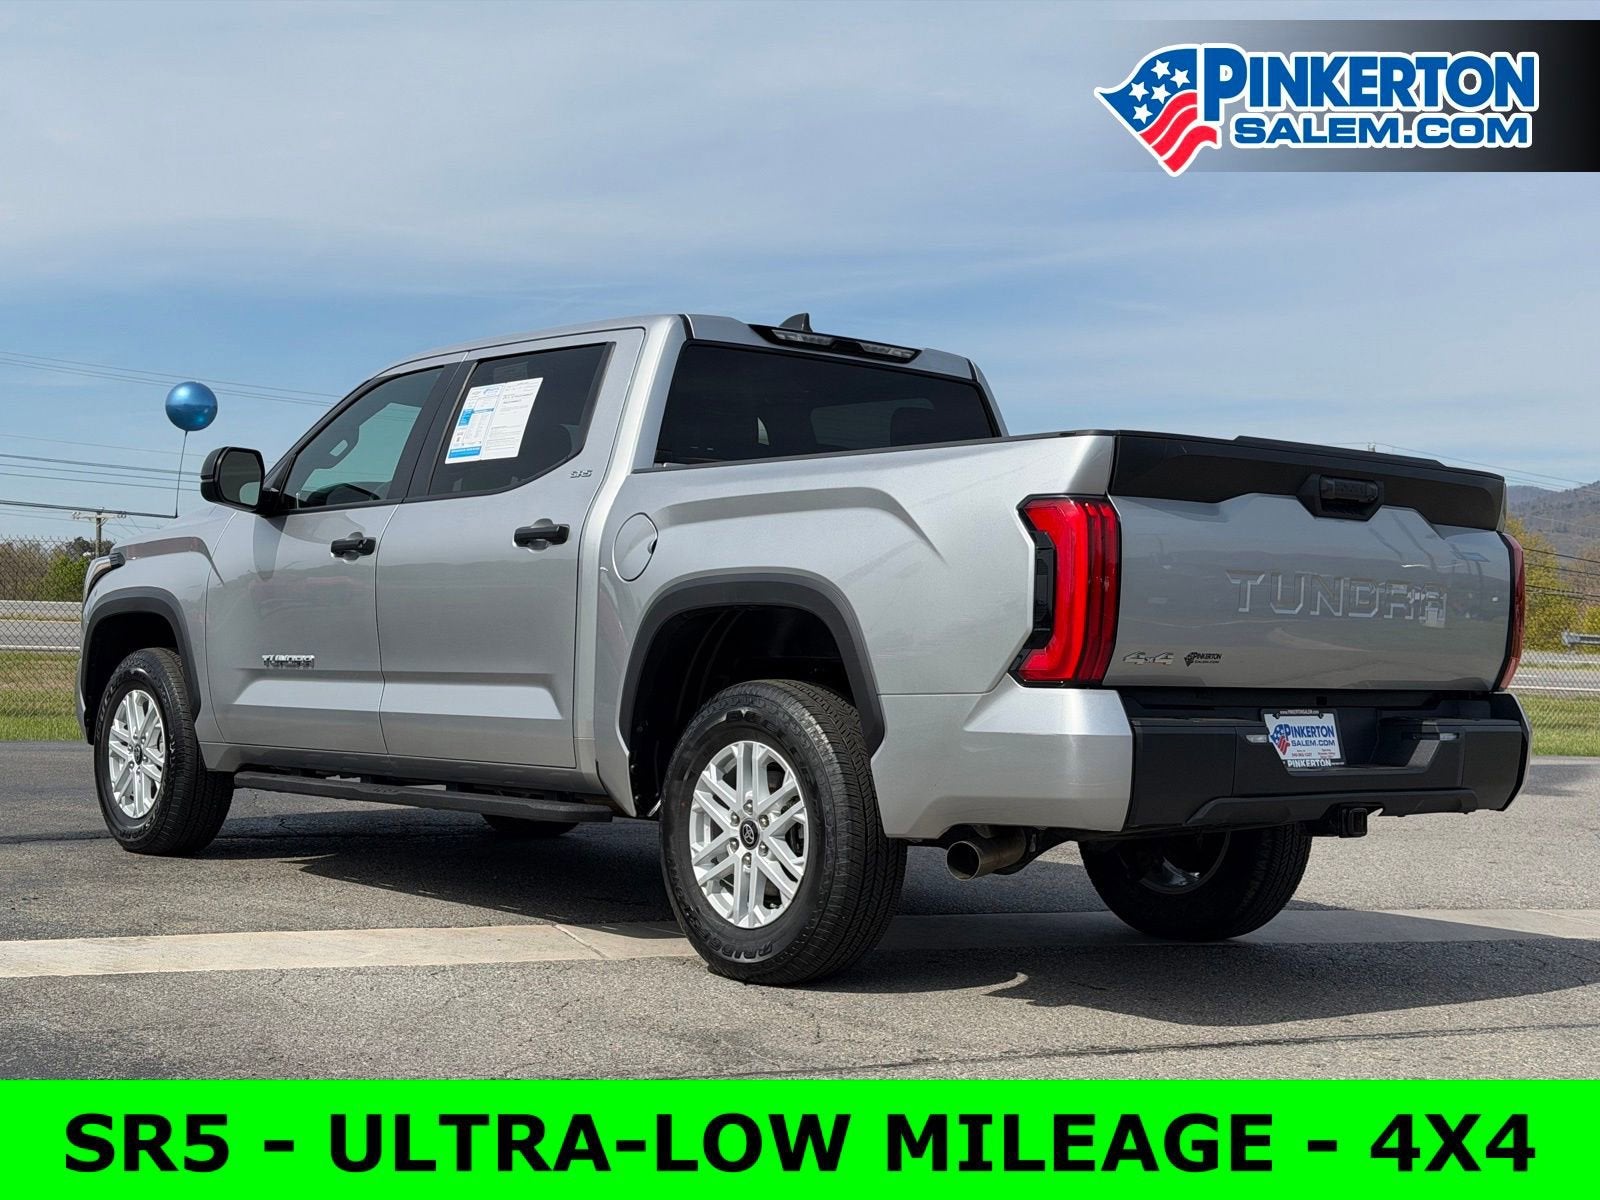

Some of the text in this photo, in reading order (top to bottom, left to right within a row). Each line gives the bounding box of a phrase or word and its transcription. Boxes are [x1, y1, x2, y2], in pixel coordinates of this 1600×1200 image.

[1225, 569, 1448, 622] TUNDRA
[1284, 724, 1335, 742] PINKERTON
[1291, 739, 1336, 747] SALEM.COM
[1287, 759, 1332, 768] PINKERTON
